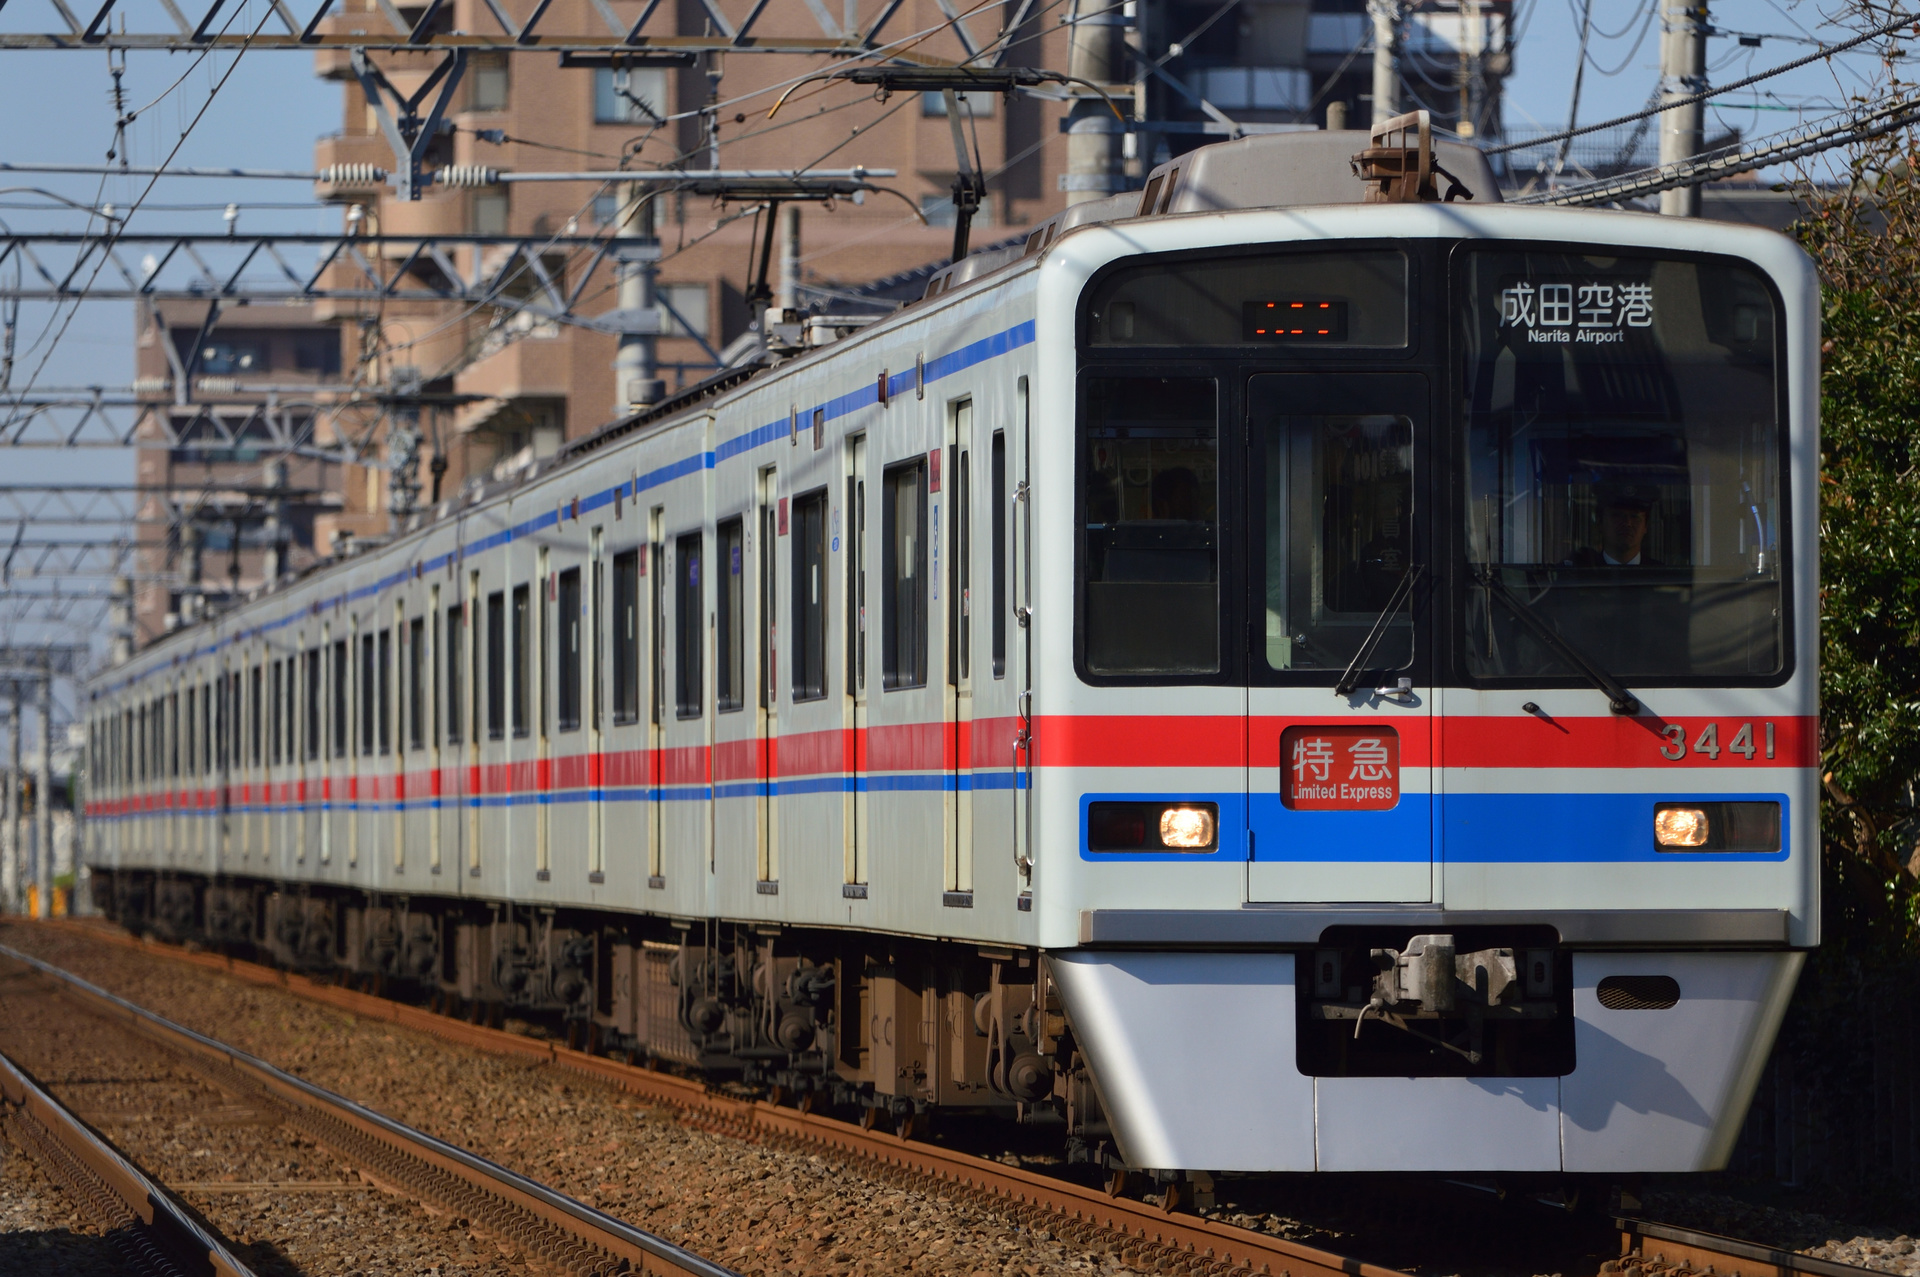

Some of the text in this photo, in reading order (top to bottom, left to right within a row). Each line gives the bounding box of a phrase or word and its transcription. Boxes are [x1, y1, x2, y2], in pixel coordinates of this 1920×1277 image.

[1500, 281, 1654, 328] 成田空港
[1527, 329, 1624, 345] Narita Airport
[1291, 738, 1393, 782] 特急
[1660, 721, 1776, 761] 3441
[1291, 783, 1393, 803] Limited Express
